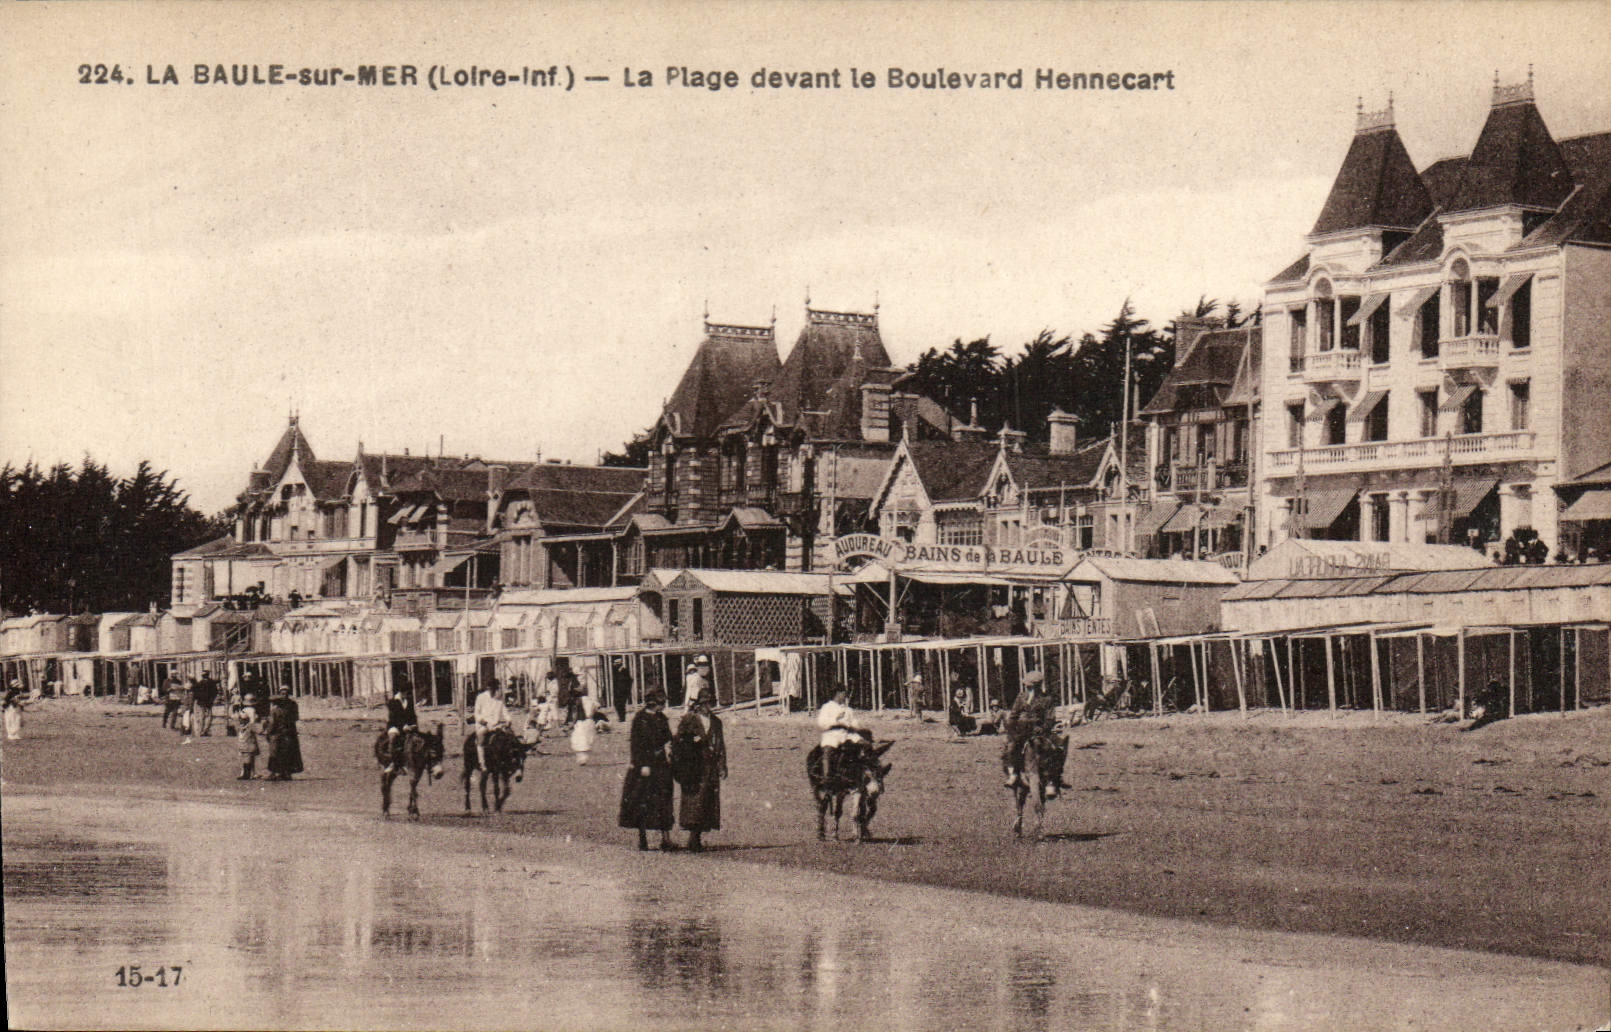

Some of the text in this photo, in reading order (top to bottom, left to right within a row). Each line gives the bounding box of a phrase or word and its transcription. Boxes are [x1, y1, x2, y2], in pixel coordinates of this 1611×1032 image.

[835, 536, 892, 558] AUDUREAU
[904, 545, 961, 562] BAINS
[1000, 551, 1064, 566] BAULE
